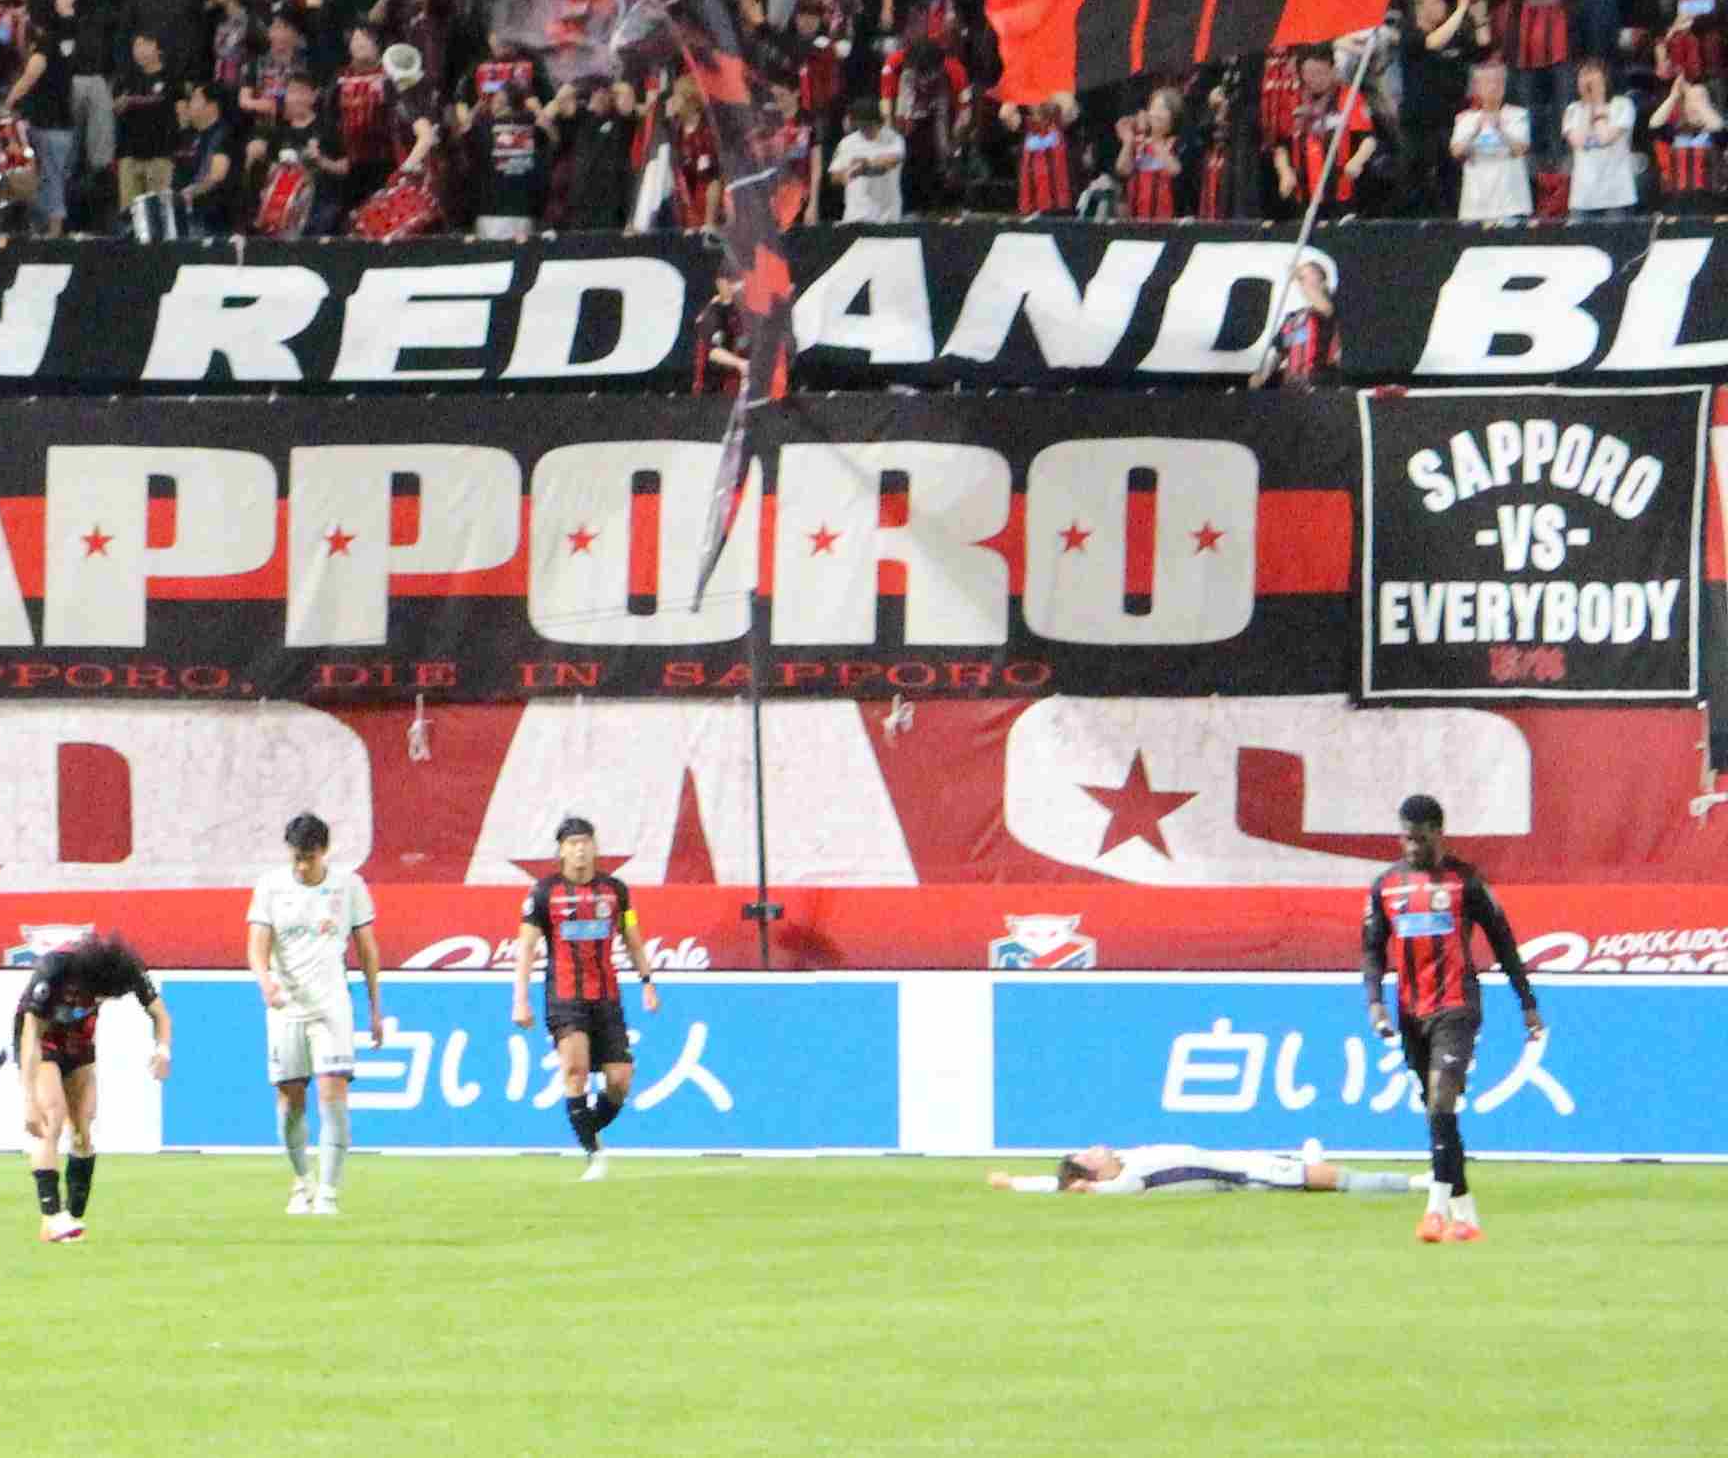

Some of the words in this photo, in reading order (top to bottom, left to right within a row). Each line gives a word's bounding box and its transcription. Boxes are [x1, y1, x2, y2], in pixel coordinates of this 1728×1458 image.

[142, 256, 686, 382] RED
[791, 232, 1341, 374] AND
[1413, 237, 1728, 375] BL
[1406, 417, 1666, 522] SAPPORO
[1378, 578, 1682, 646] EVERYBODY
[314, 661, 459, 689] DIE
[518, 660, 601, 688] IN
[662, 660, 1054, 689] SAPPORO
